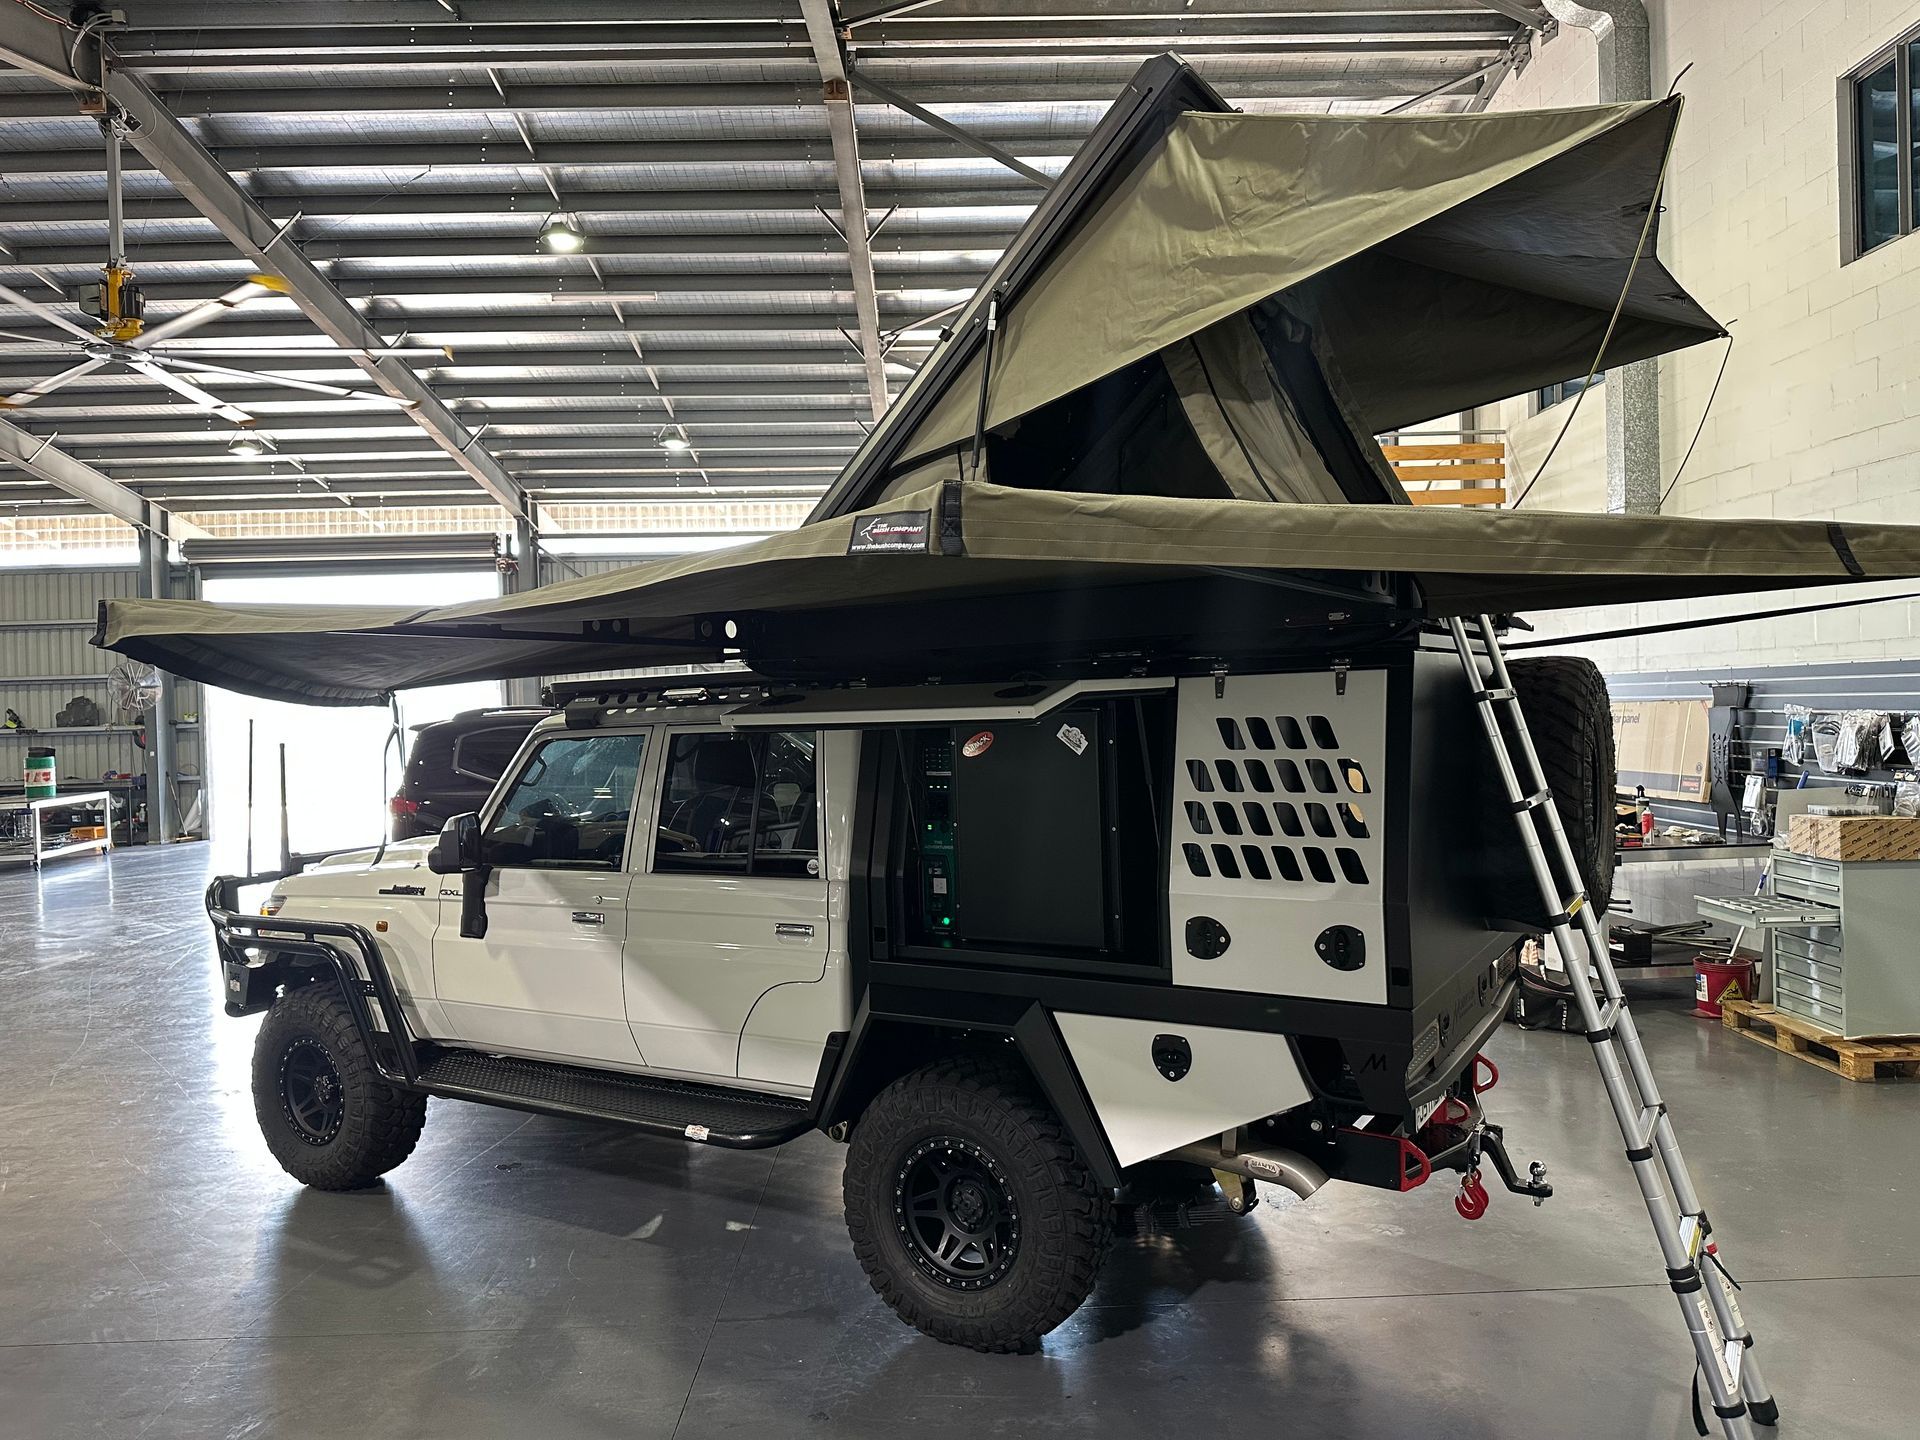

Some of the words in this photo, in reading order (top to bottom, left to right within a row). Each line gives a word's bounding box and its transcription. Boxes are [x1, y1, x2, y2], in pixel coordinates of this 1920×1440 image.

[872, 526, 890, 534] BUSH
[890, 525, 924, 533] COMPANY
[851, 542, 926, 551] www.thebushcompany.com
[440, 888, 463, 897] GXL
